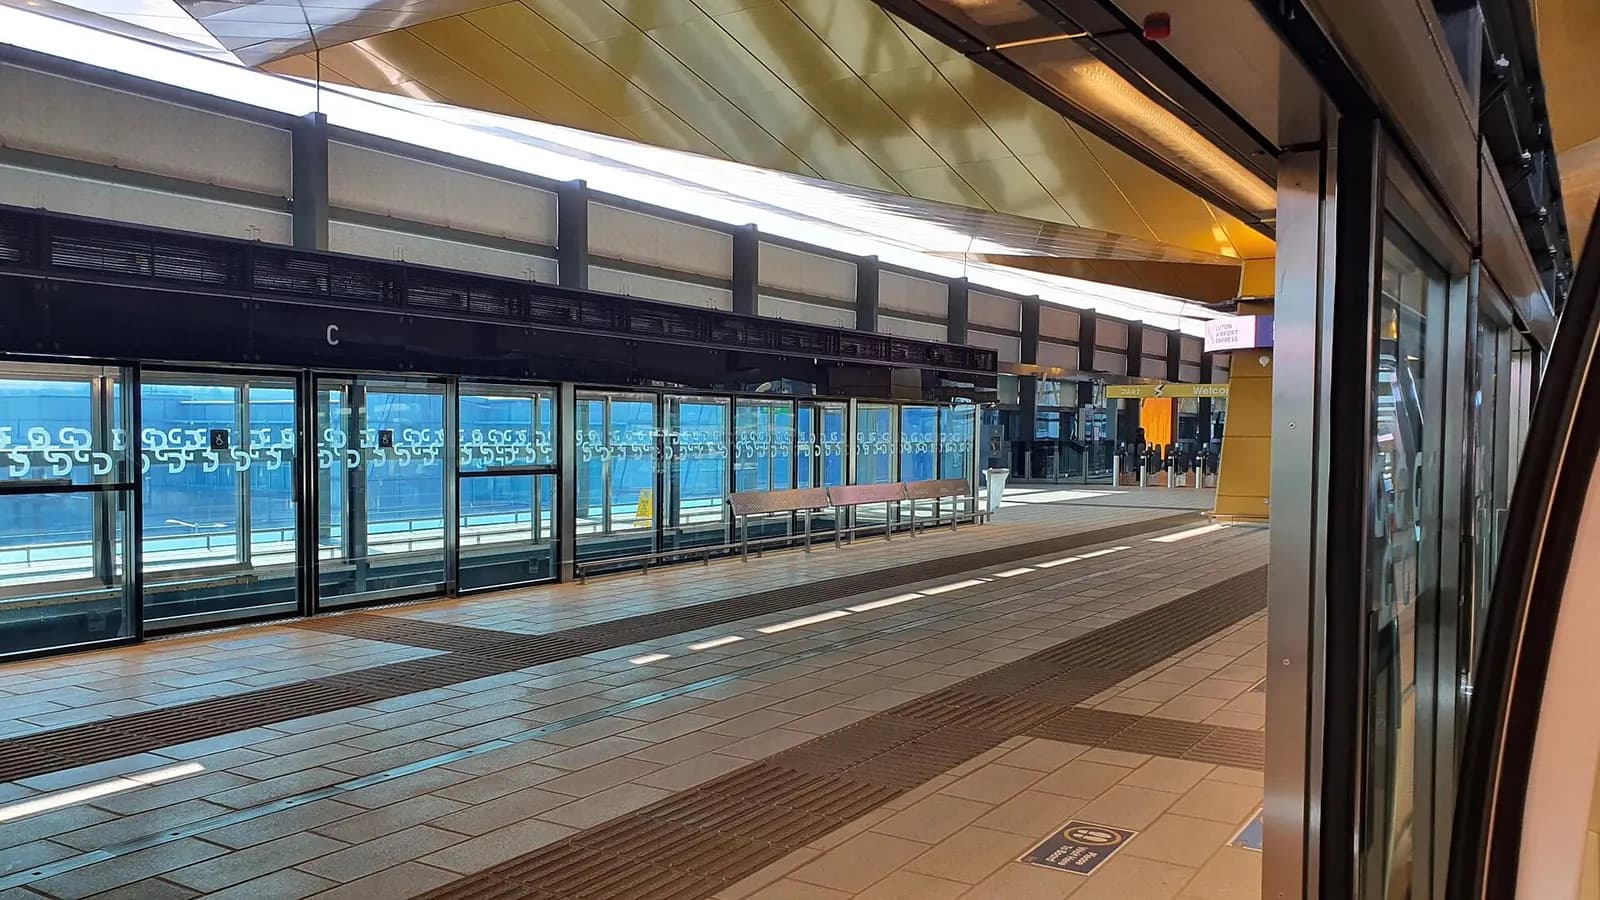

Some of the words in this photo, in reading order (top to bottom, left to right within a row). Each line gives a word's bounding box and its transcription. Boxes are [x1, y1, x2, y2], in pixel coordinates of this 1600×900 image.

[1215, 323, 1233, 331] LUTON
[327, 324, 339, 346] C
[1215, 329, 1239, 337] AIRPORT
[1192, 386, 1230, 395] Welco
